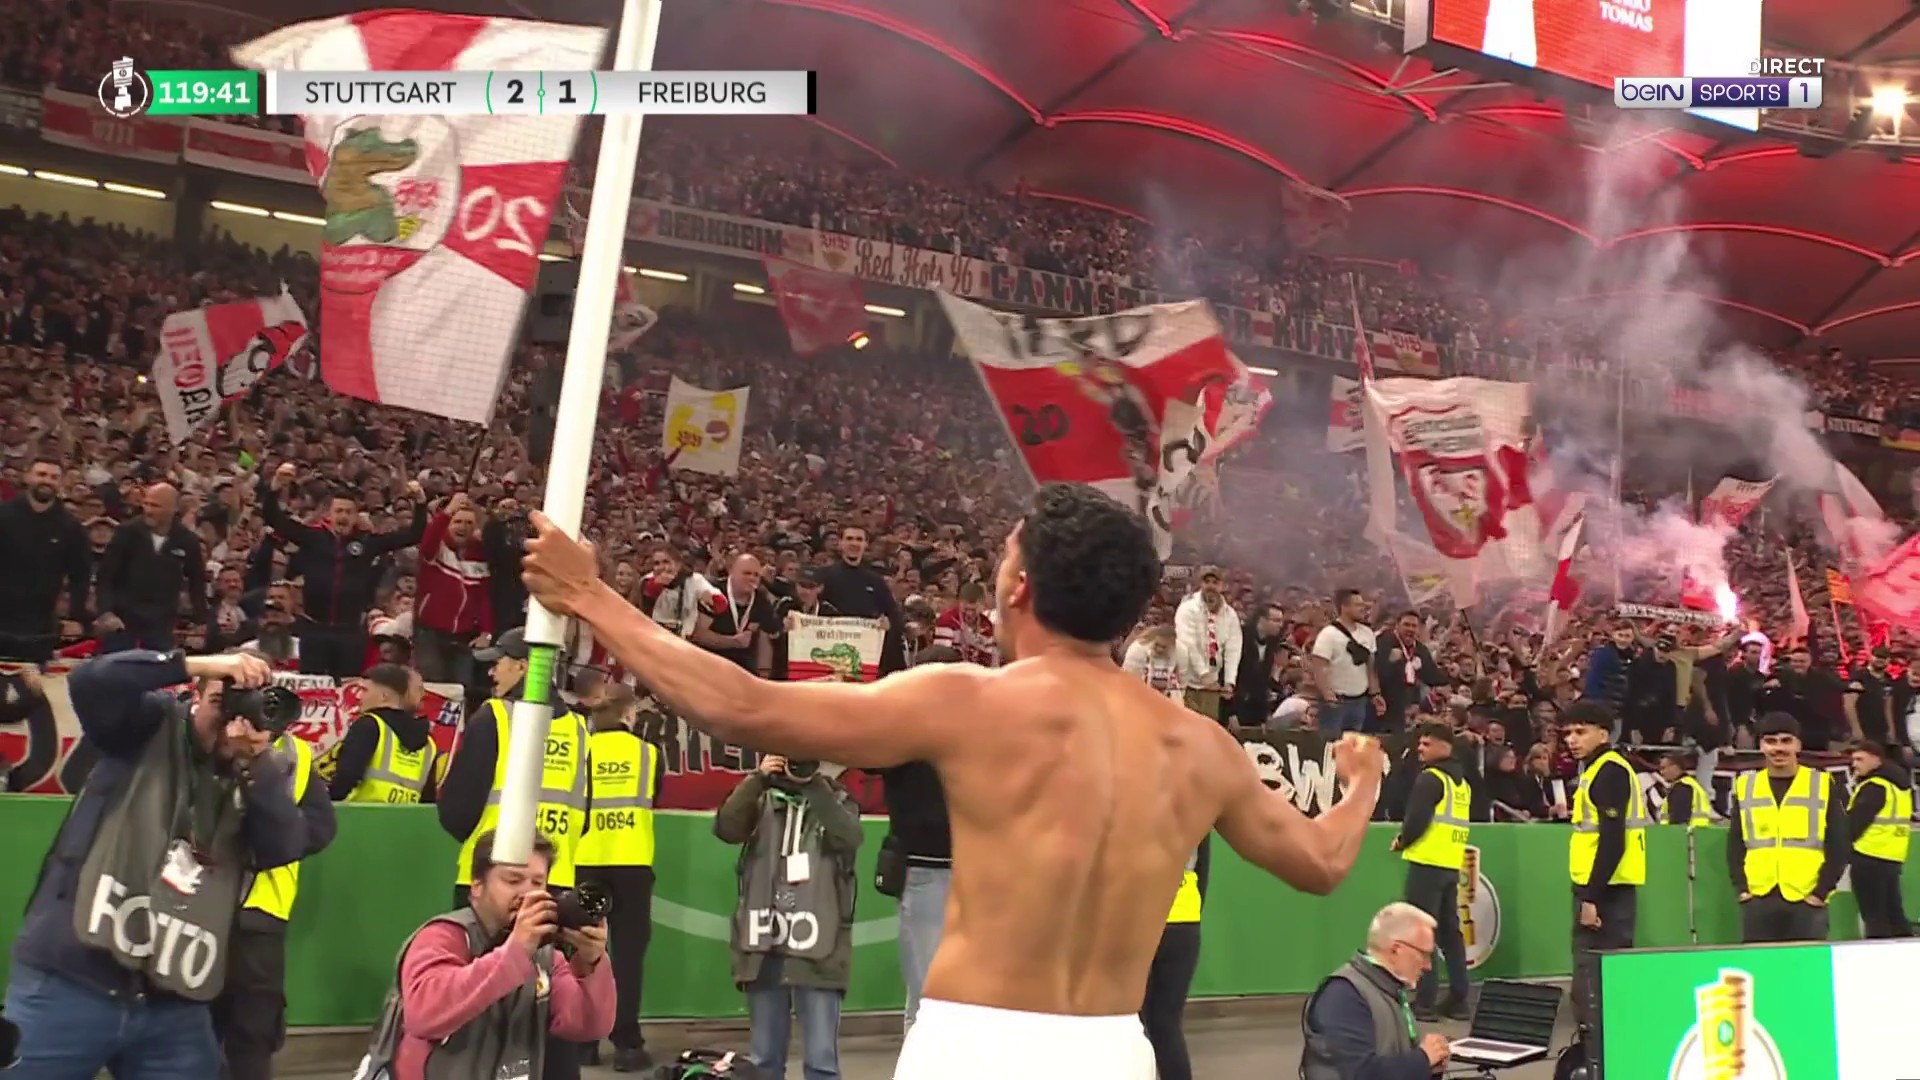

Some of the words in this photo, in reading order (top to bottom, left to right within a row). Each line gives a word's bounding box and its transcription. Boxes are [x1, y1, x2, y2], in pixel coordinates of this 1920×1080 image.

[1600, 2, 1654, 32] TOMAS
[658, 208, 783, 255] BERKHEIM
[854, 238, 894, 282] Red
[899, 245, 945, 287] Hots
[950, 254, 974, 296] 96
[1010, 404, 1071, 447] 20
[543, 738, 572, 757] DS
[596, 760, 632, 775] SDS
[596, 811, 636, 831] 0694
[88, 873, 218, 989] FOTO
